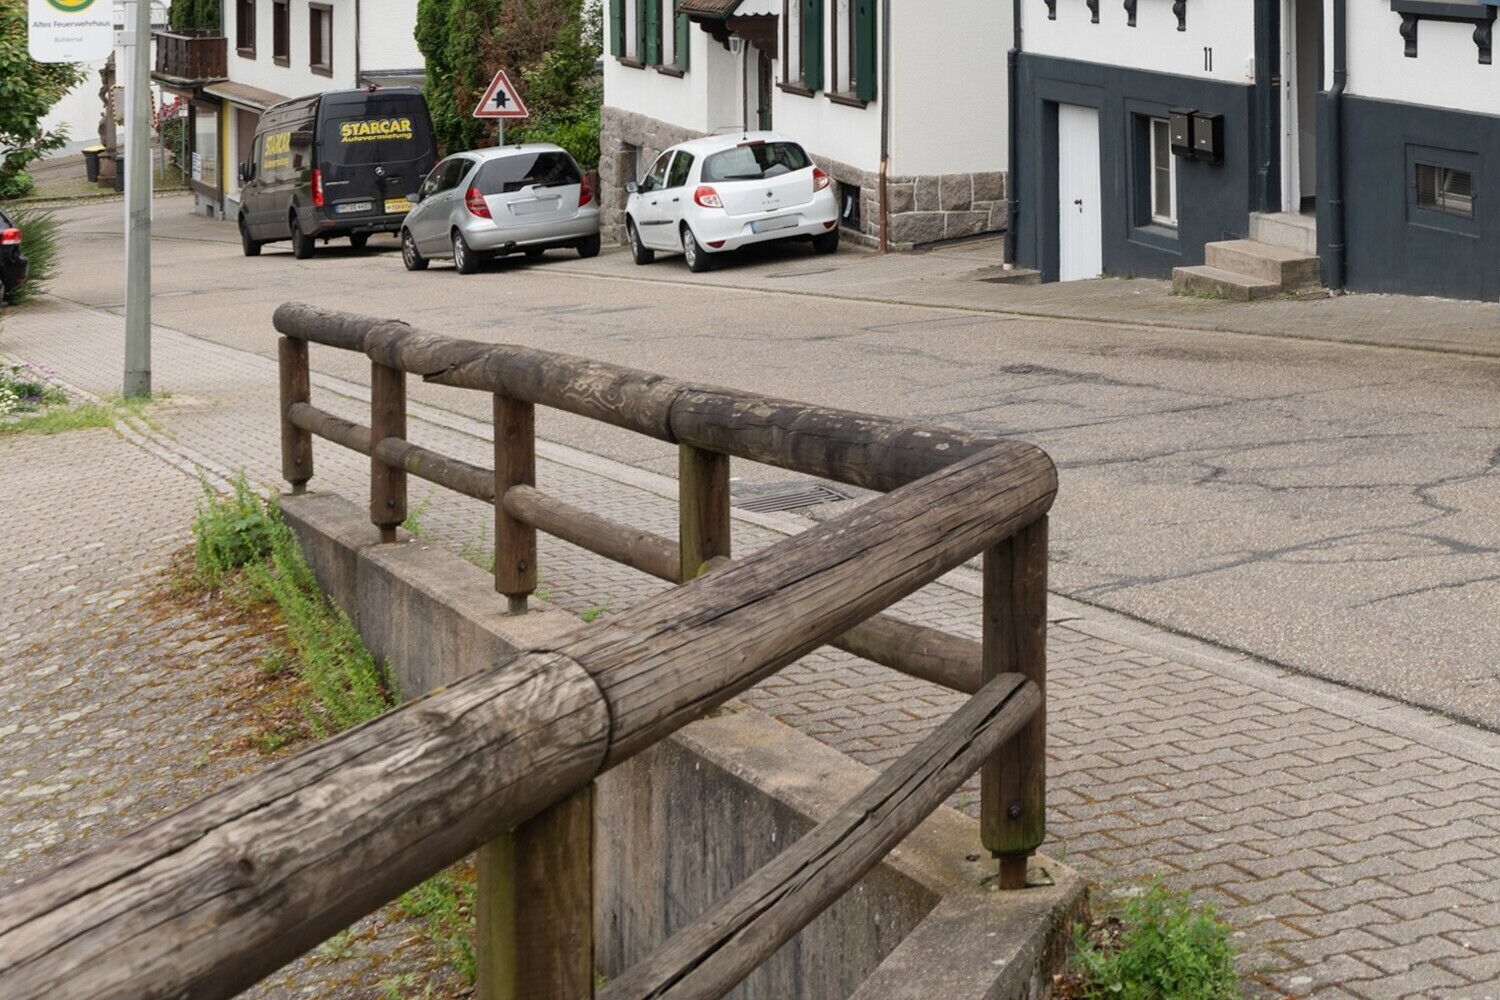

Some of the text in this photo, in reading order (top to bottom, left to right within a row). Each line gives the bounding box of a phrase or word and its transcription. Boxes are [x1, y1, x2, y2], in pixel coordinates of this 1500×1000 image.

[53, 20, 111, 28] Feuerwehrhaus
[1203, 46, 1213, 72] 11
[340, 118, 412, 137] STARCAR
[340, 132, 413, 143] Autovermietung
